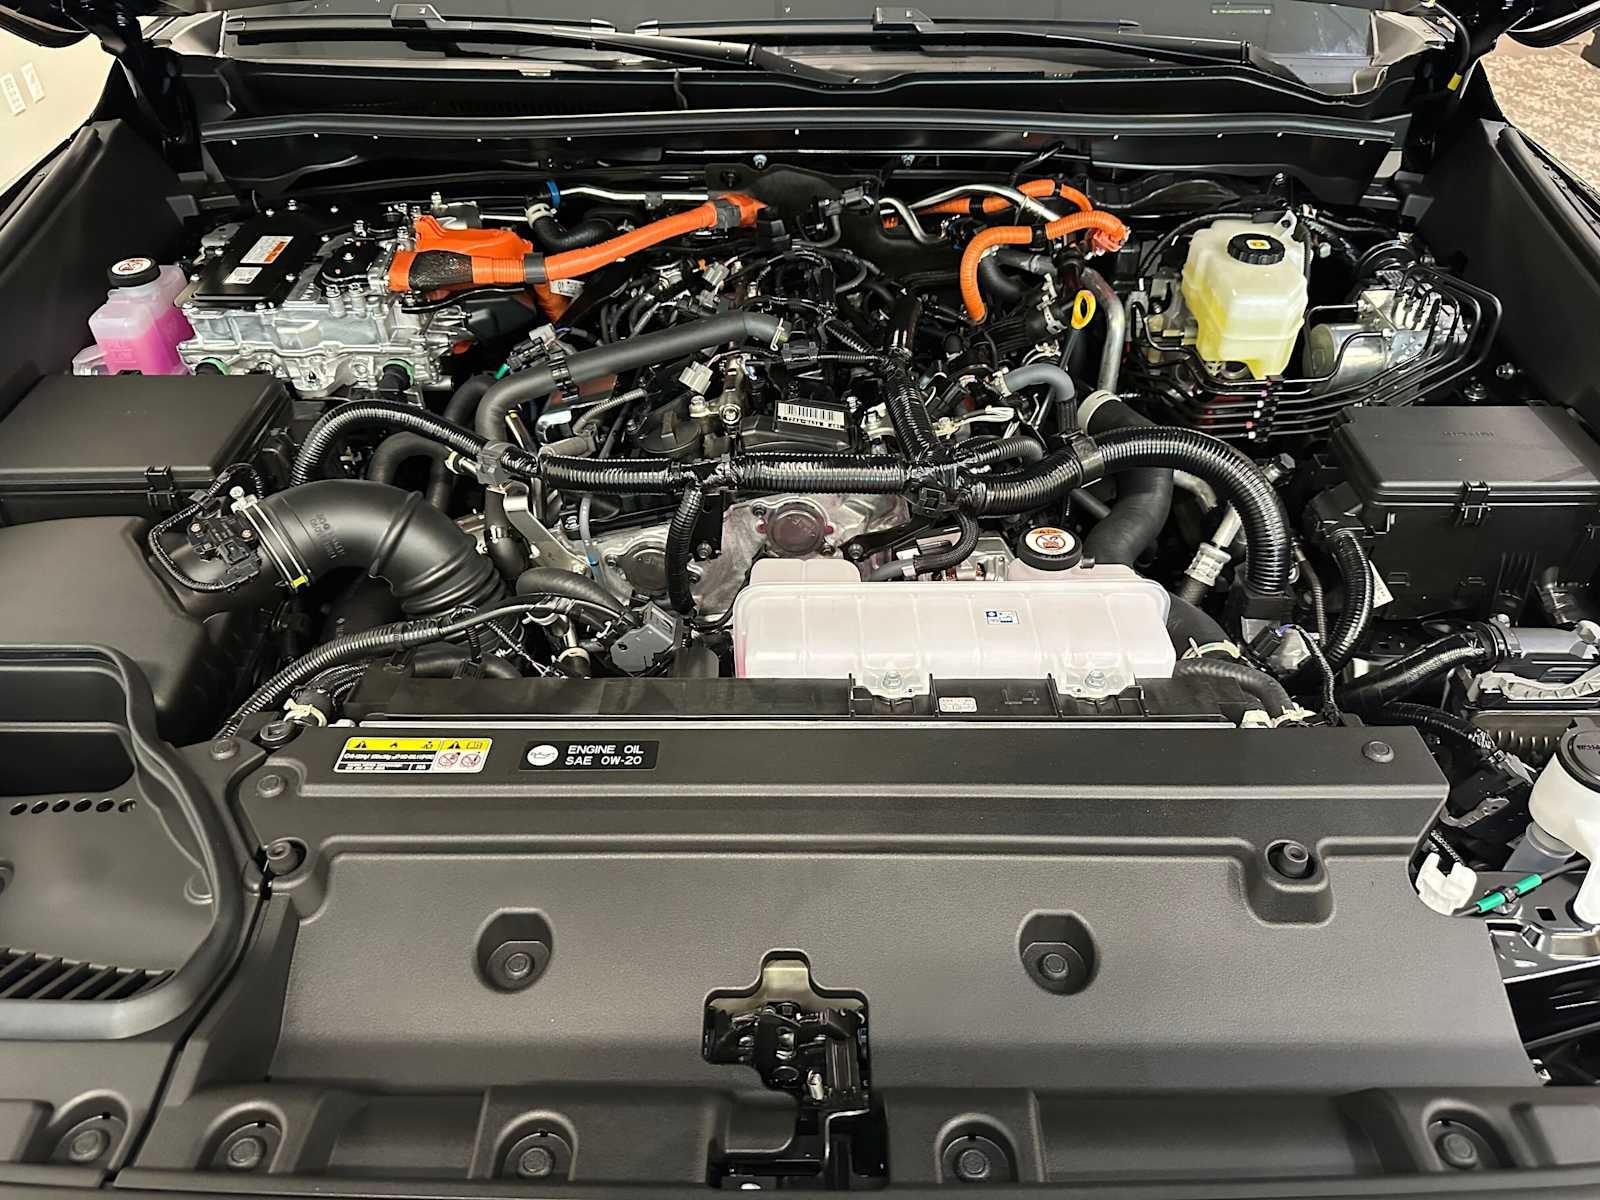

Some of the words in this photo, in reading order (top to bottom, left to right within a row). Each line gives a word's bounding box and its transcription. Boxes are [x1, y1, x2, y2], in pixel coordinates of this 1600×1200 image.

[567, 744, 617, 755] ENGINE
[623, 744, 645, 755] OIL
[565, 755, 593, 766] SAE
[600, 755, 643, 765] 0W-20
